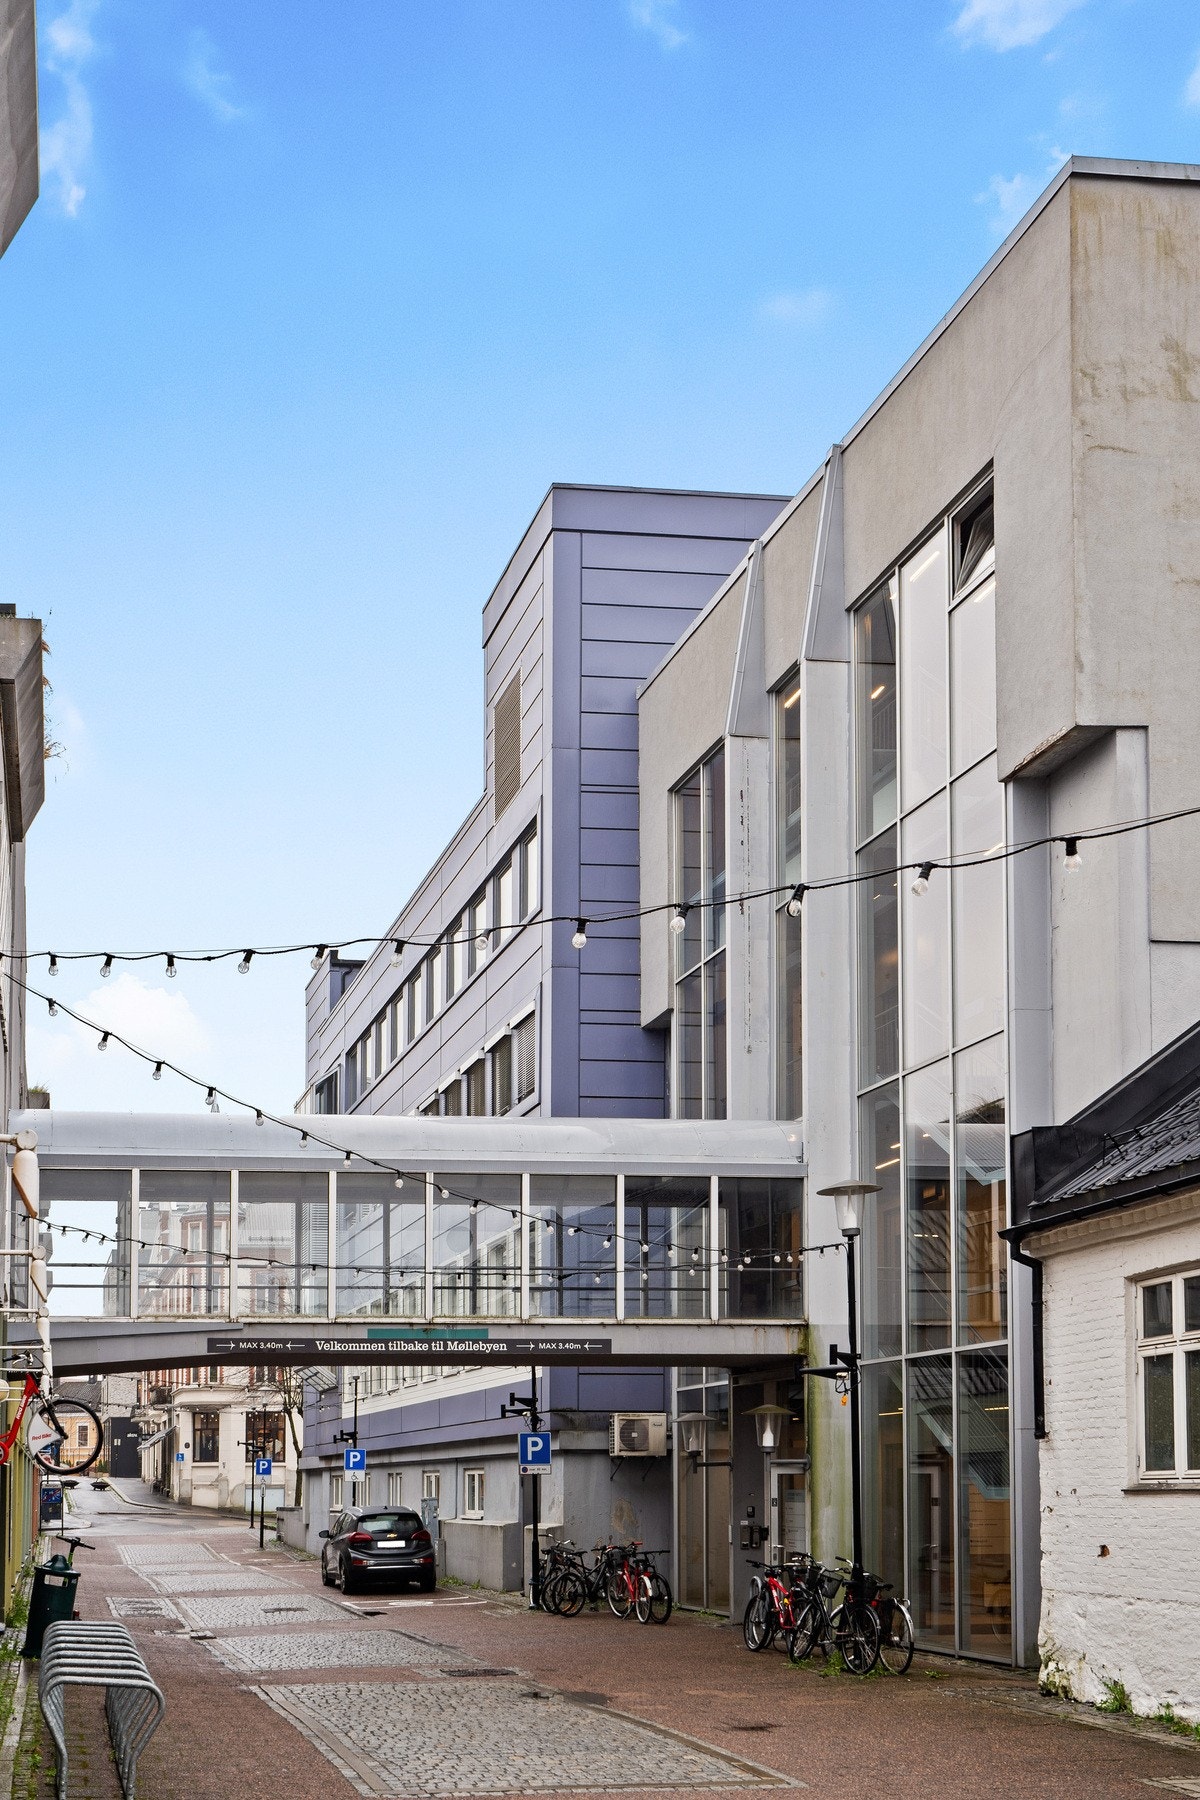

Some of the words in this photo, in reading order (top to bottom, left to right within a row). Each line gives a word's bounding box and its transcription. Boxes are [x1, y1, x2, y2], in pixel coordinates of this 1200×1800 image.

[239, 1341, 258, 1349] MAX
[259, 1341, 284, 1349] 3.40m
[315, 1340, 386, 1351] Velkommen
[388, 1340, 429, 1351] tilbake
[431, 1340, 445, 1351] til
[446, 1340, 508, 1353] Møllebyen
[538, 1342, 557, 1350] MAX
[558, 1342, 581, 1350] 3.40m
[527, 1436, 543, 1461] P
[349, 1451, 361, 1468] P
[259, 1460, 268, 1473] P
